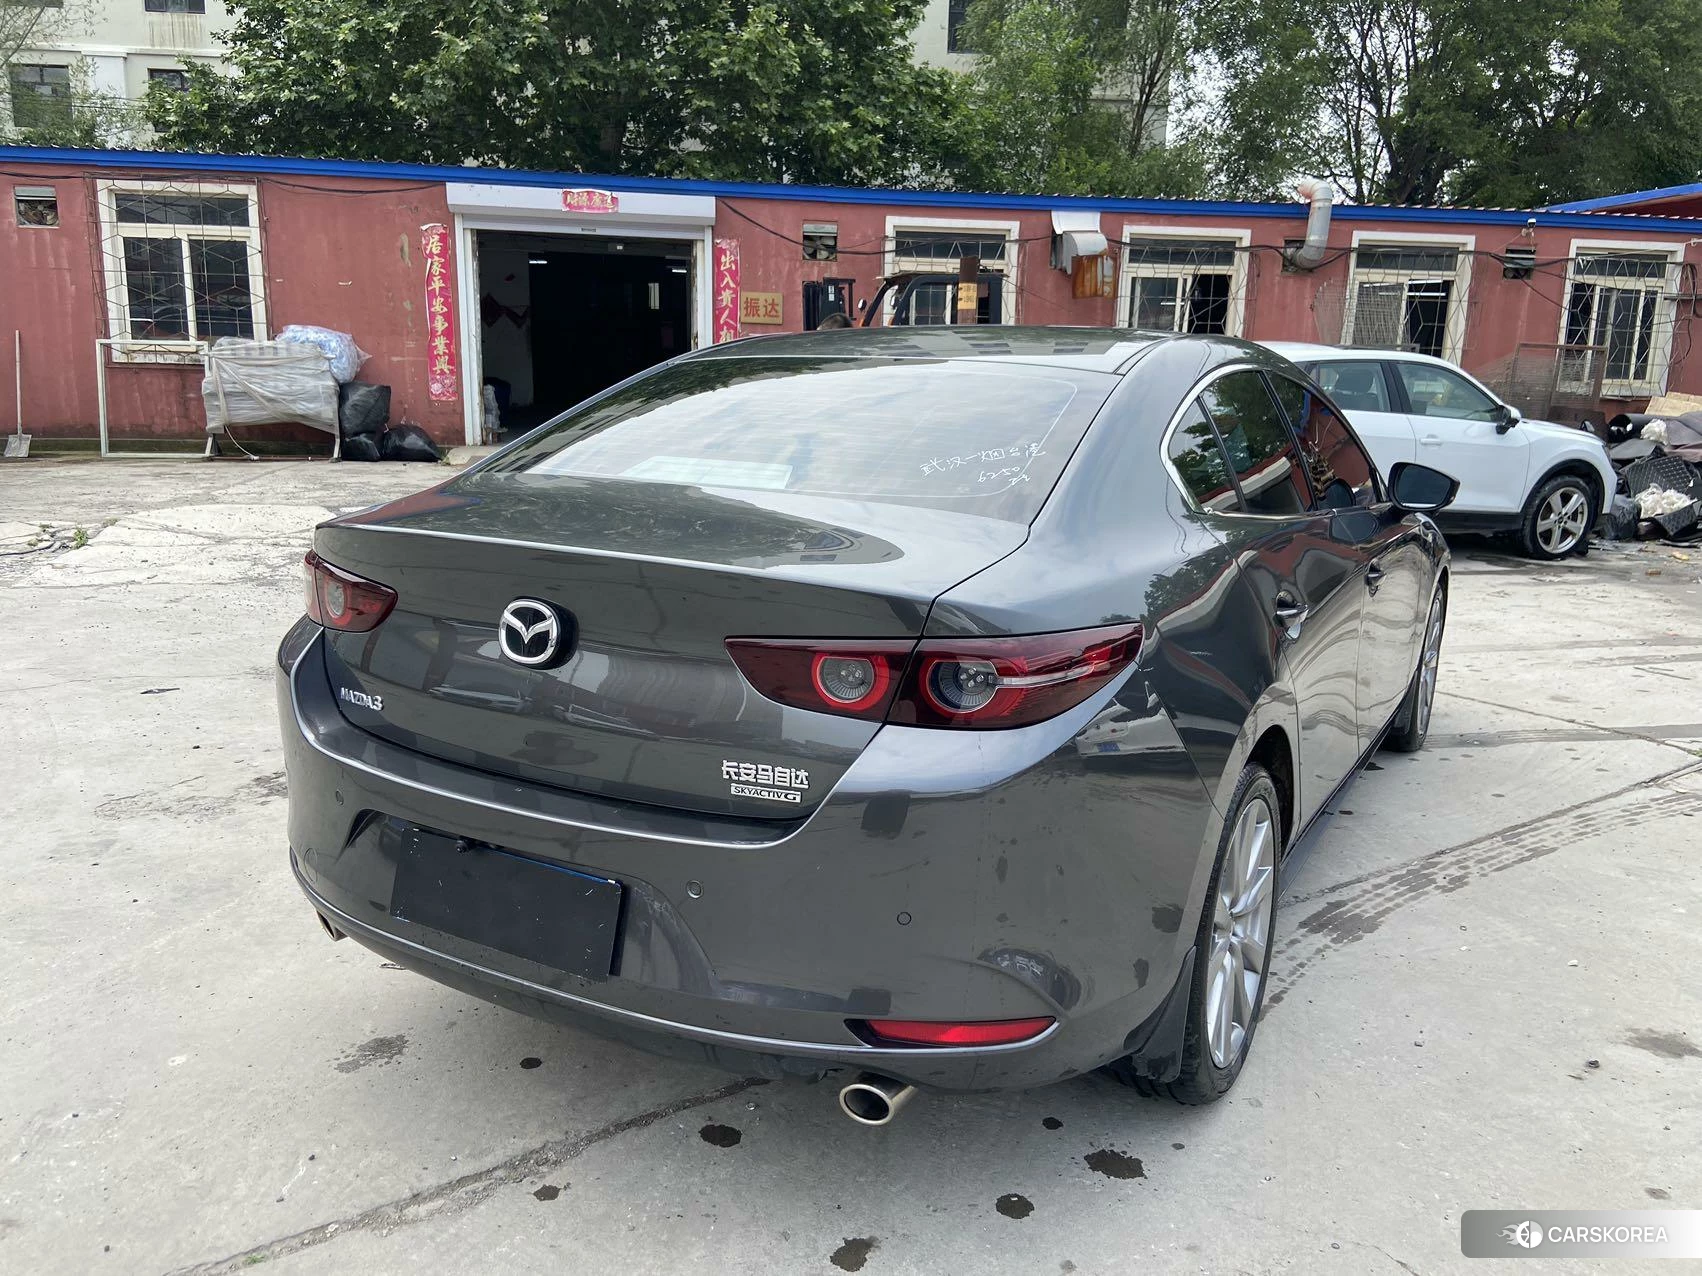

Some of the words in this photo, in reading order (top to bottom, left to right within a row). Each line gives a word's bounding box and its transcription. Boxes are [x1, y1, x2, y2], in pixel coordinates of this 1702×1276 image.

[744, 297, 780, 318] 振达
[721, 759, 810, 789] 长安马自达
